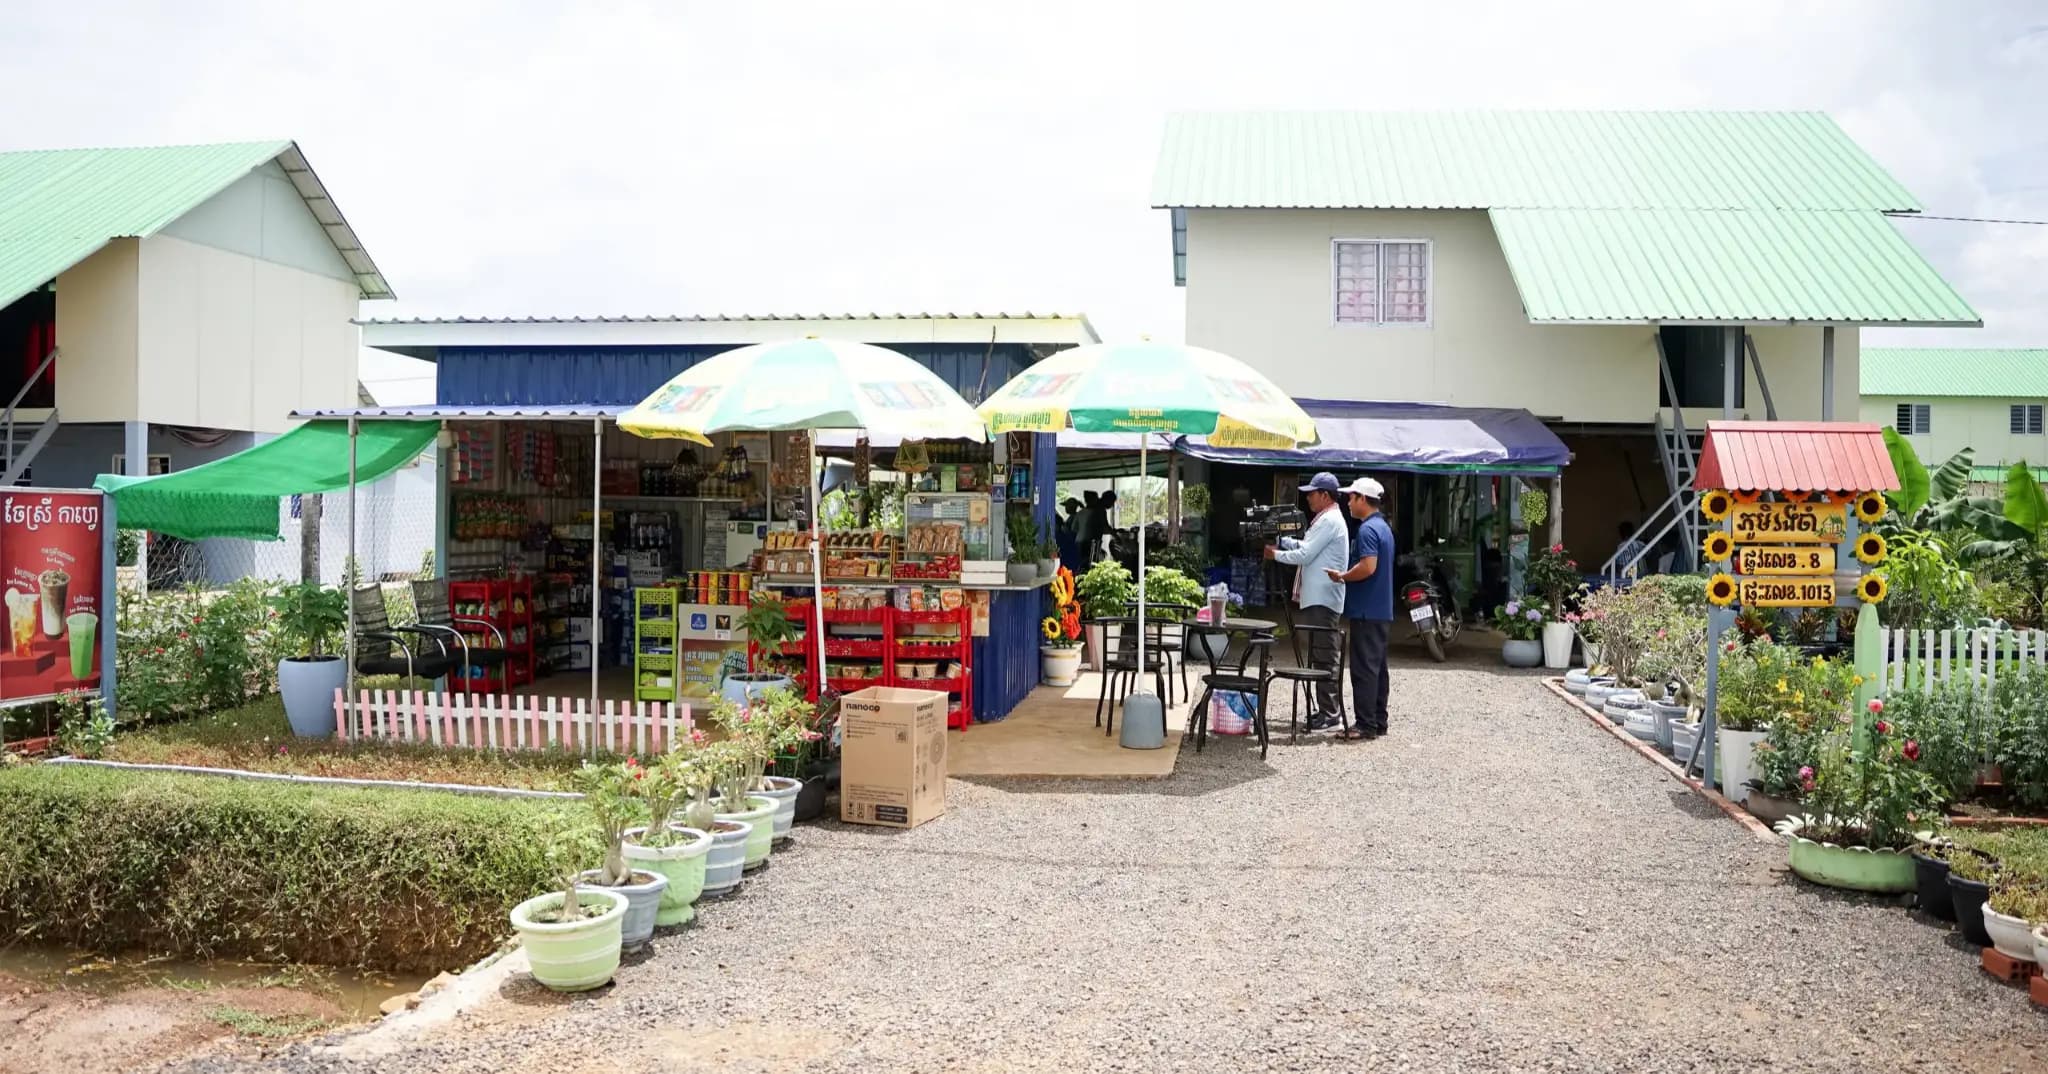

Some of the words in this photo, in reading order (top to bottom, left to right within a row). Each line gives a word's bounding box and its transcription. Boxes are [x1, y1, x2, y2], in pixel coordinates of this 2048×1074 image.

[58, 505, 98, 530] កាហ្វេ
[1810, 553, 1820, 568] 8
[846, 703, 881, 712] nanoco
